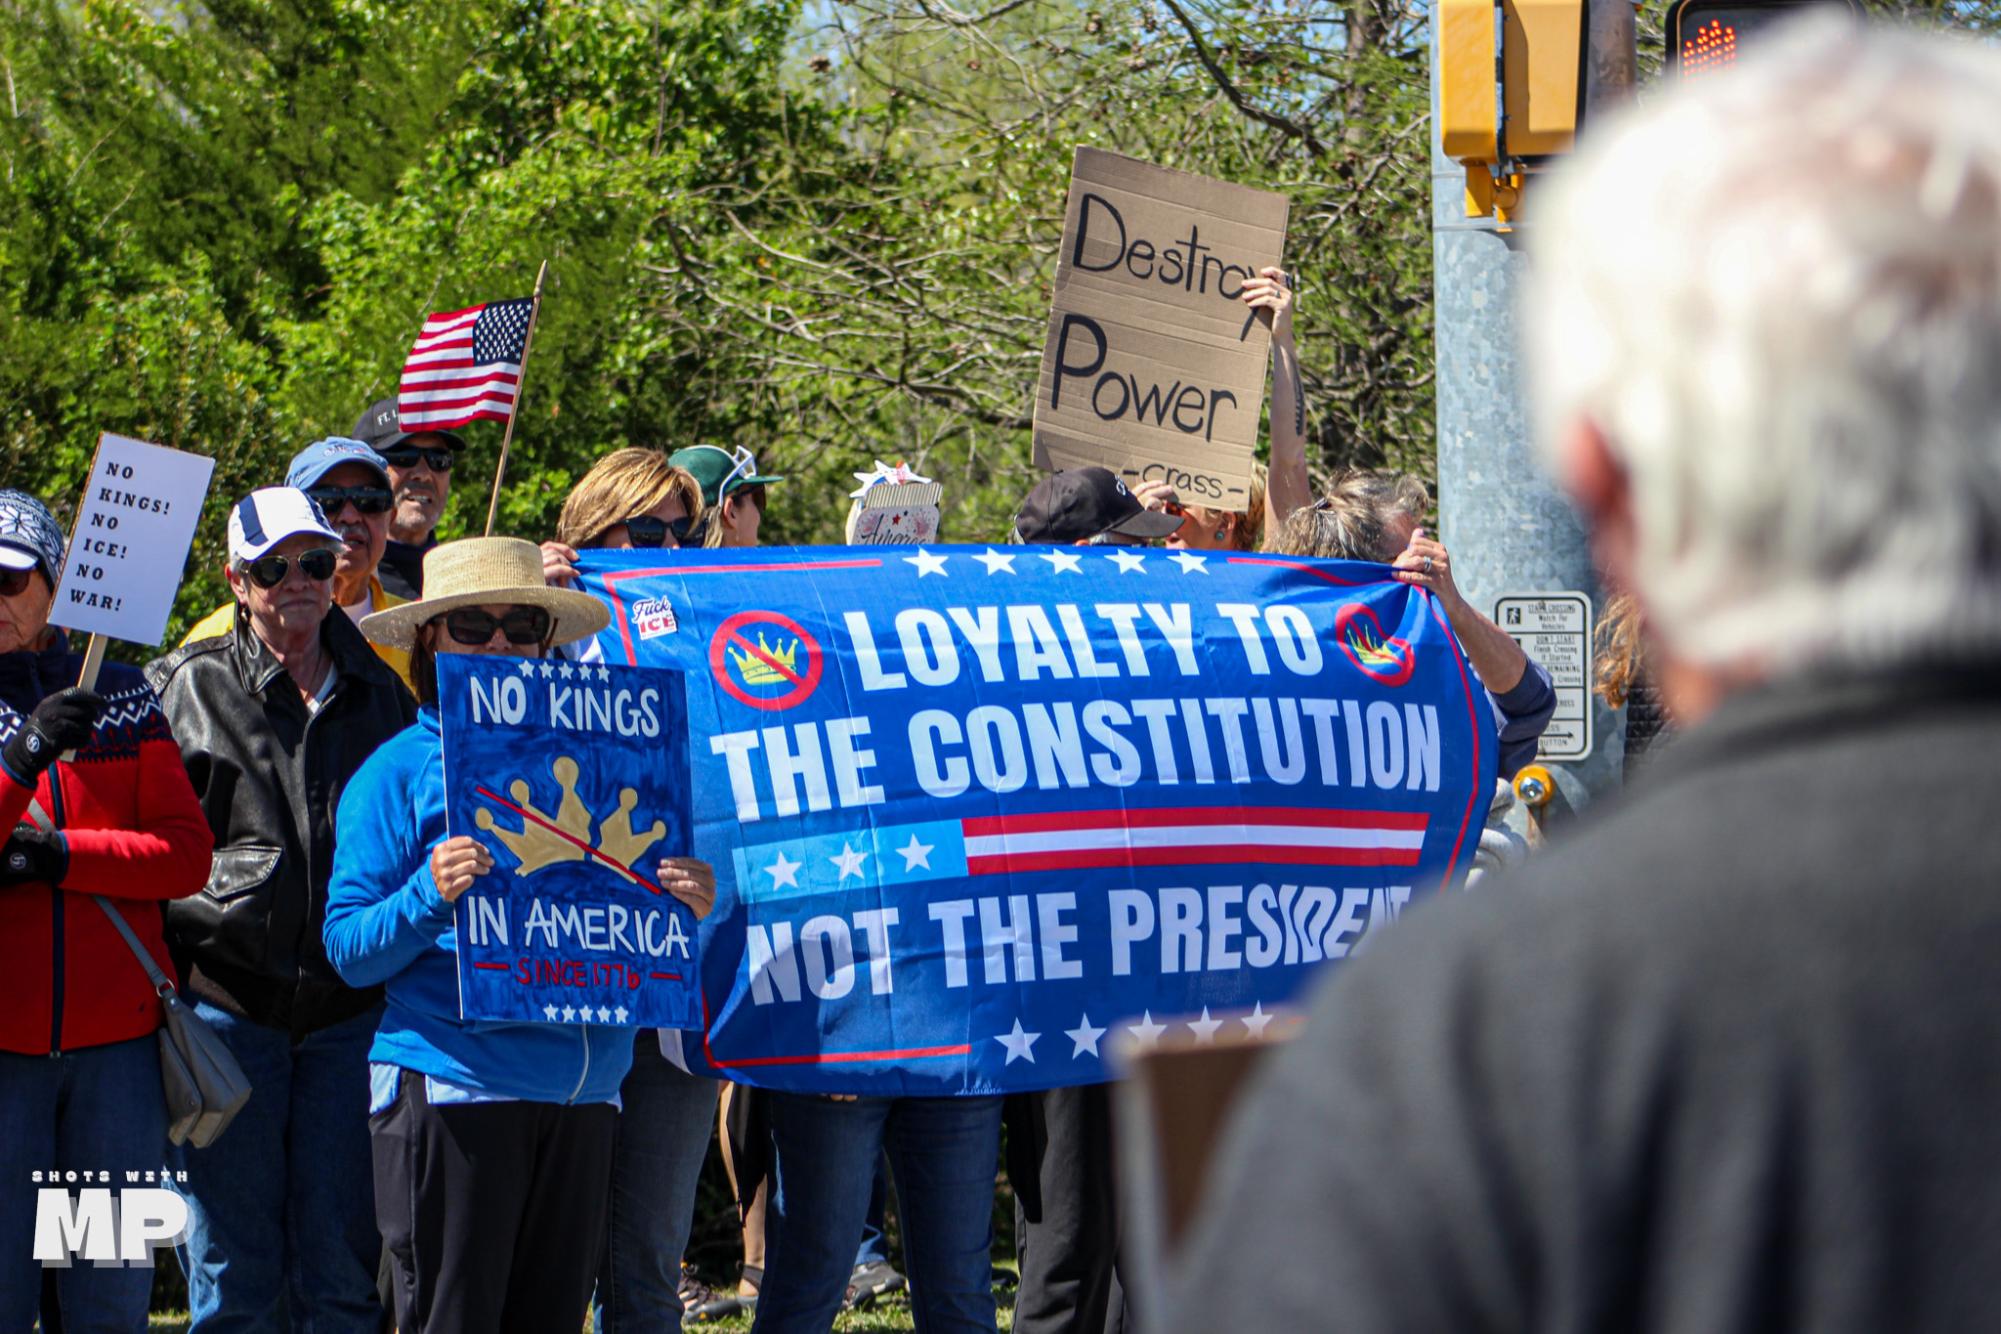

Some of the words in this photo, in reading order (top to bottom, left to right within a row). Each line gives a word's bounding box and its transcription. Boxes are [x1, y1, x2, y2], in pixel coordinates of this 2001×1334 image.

[1051, 313, 1237, 442] Power
[105, 461, 134, 480] NO
[98, 487, 171, 515] KINGS!
[91, 513, 119, 530] NO
[83, 538, 128, 559] ICE!
[76, 563, 104, 581] NO
[70, 588, 122, 612] WAR!
[640, 615, 675, 634] ICE
[843, 602, 1200, 692] LOYALTY
[1216, 603, 1324, 676] TO
[470, 675, 526, 725] NO
[550, 683, 660, 737] KINGS
[710, 716, 886, 823] THE
[908, 697, 1441, 798] CONSTITUTION
[468, 896, 509, 946] IN
[524, 898, 690, 959] AMERICA
[747, 907, 899, 1006] NOT
[928, 891, 1083, 989] THE
[515, 957, 587, 987] SINCE
[593, 962, 641, 989] 1776
